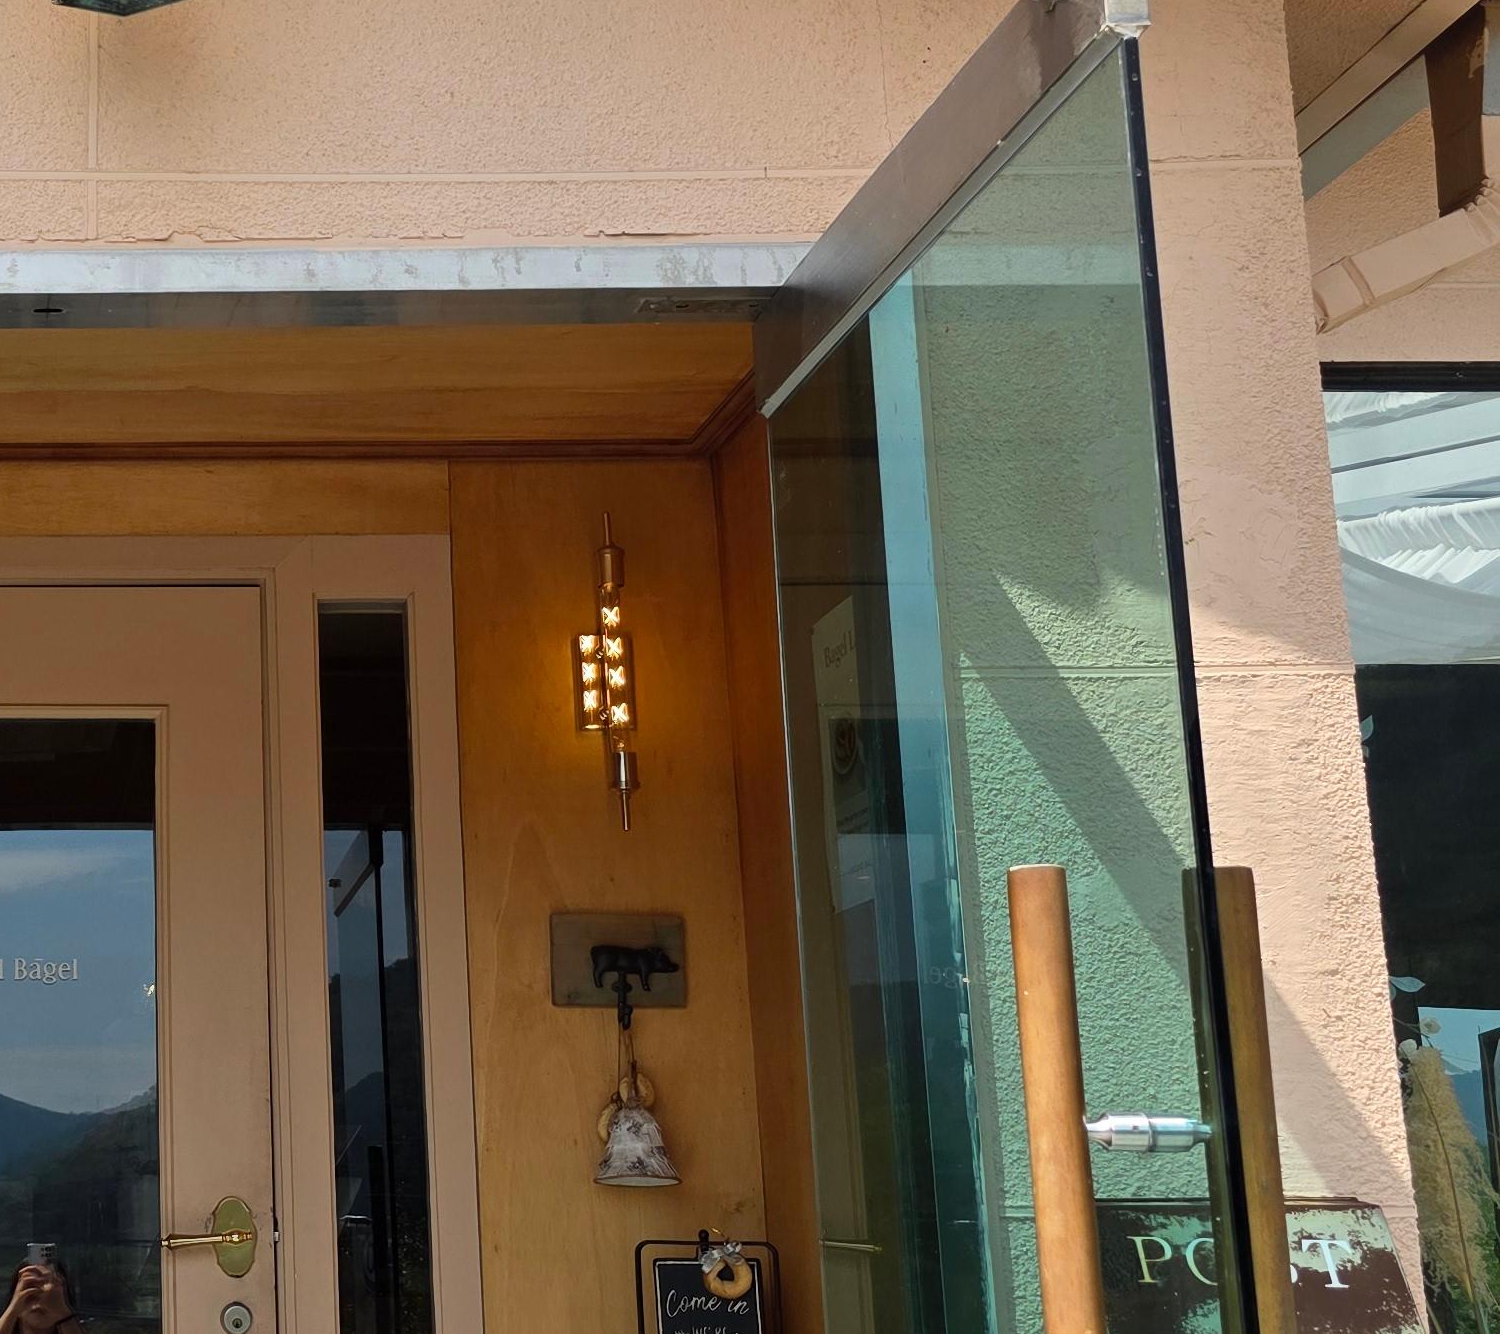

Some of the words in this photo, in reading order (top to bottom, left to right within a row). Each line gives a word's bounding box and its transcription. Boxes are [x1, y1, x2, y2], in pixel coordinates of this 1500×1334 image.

[1127, 1236, 1353, 1289] POT
[666, 1288, 722, 1318] Come
[727, 1296, 750, 1316] in
